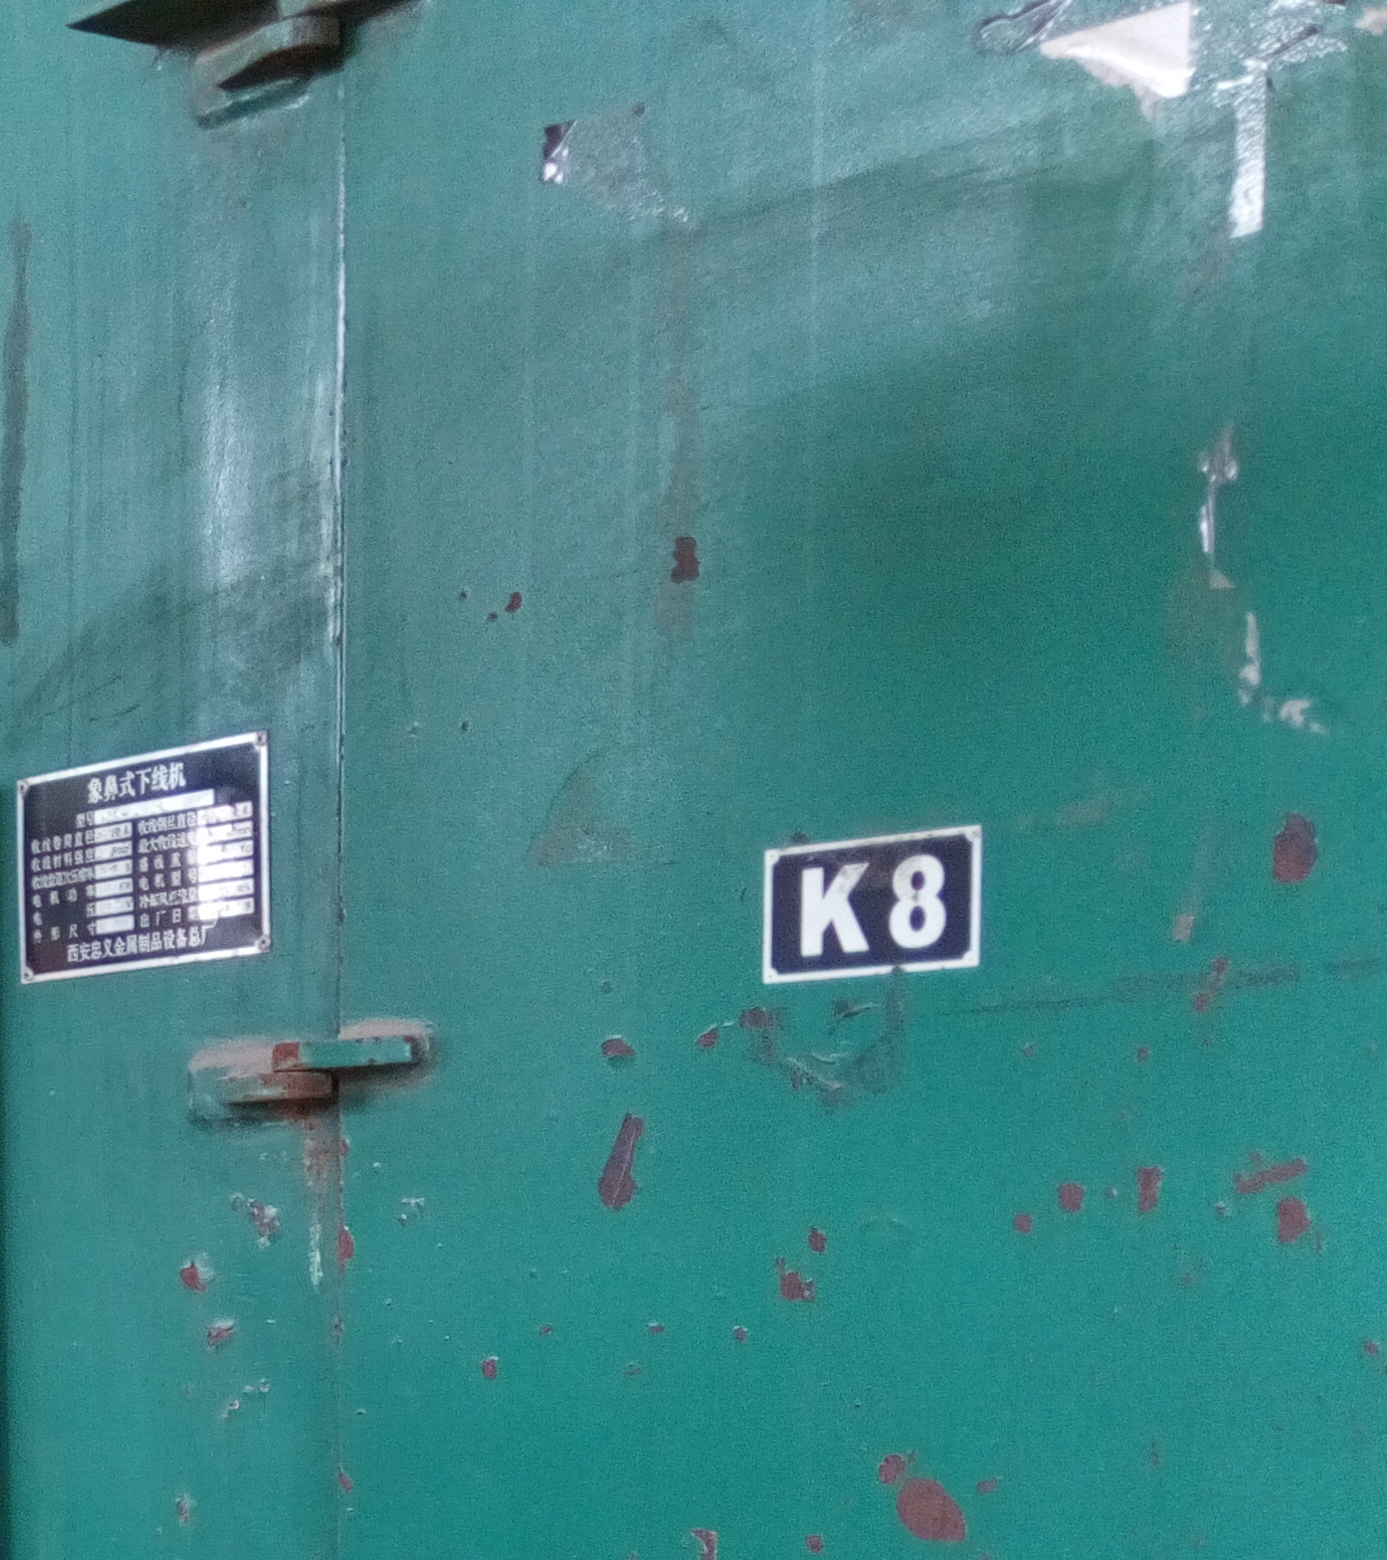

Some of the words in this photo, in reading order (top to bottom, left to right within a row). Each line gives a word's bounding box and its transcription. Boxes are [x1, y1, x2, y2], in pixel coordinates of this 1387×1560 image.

[88, 762, 187, 804] 象鼻式下线机
[800, 854, 946, 957] K8
